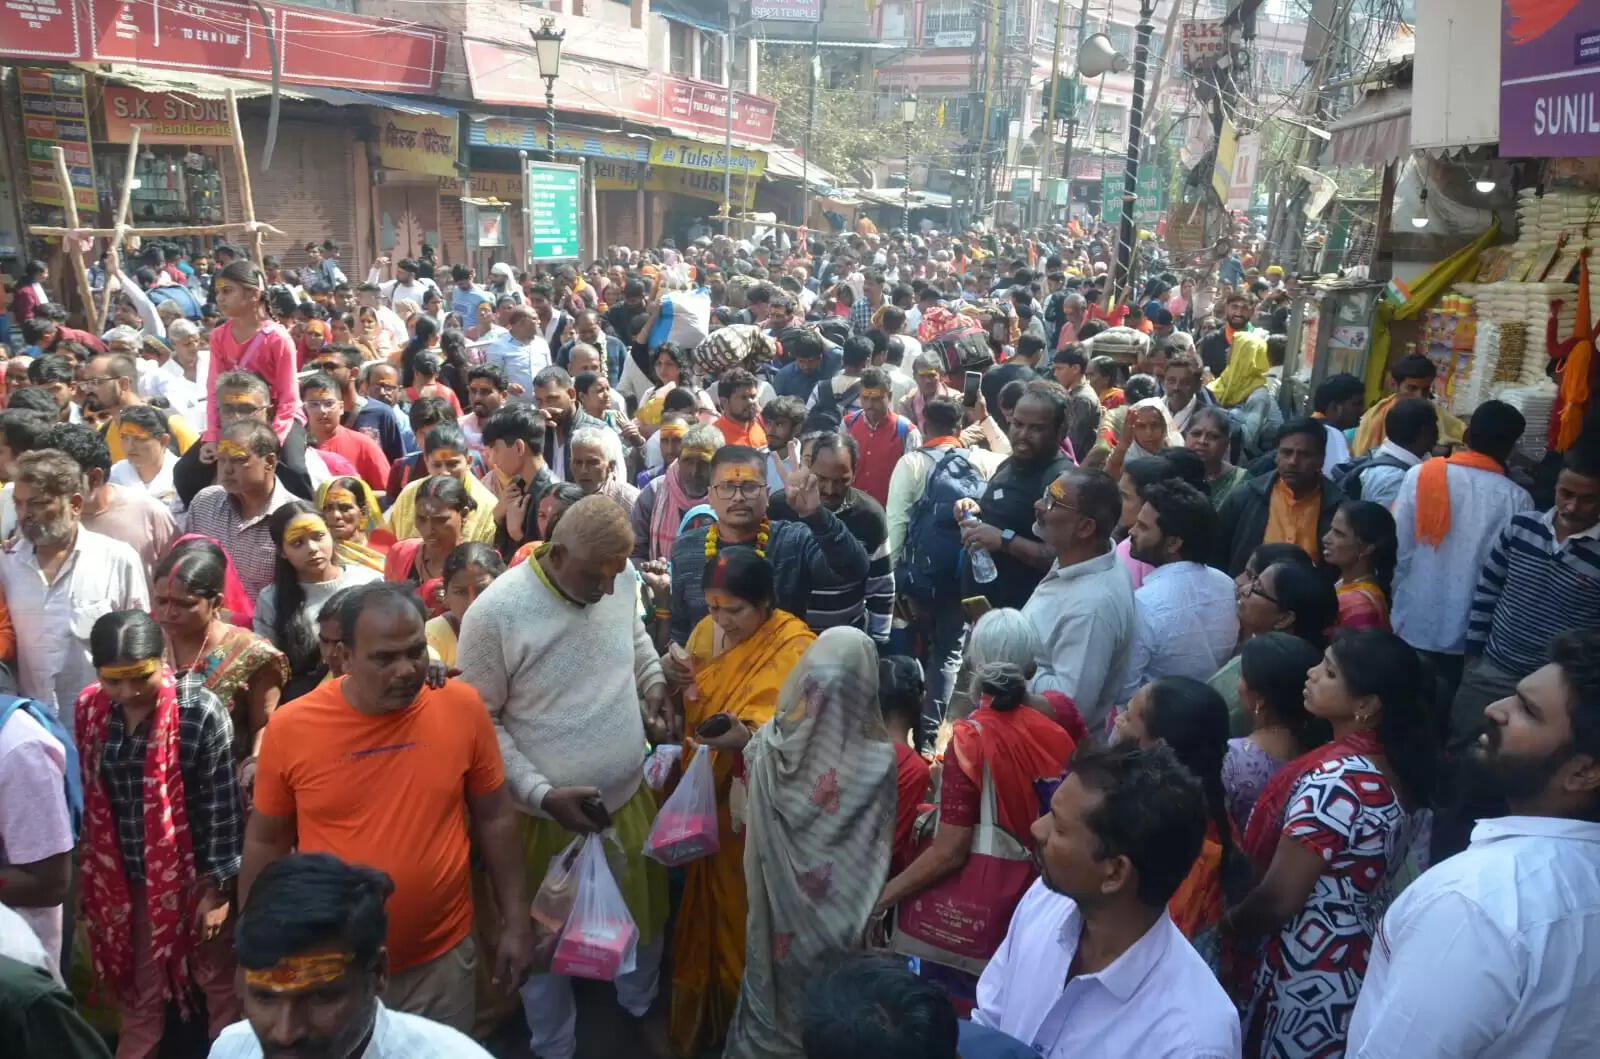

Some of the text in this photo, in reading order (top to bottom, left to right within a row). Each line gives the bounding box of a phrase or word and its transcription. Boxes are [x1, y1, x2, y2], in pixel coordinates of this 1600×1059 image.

[781, 8, 817, 17] TEMPLE
[164, 99, 230, 121] STONE
[1534, 92, 1600, 135] SUNIL
[680, 145, 713, 167] Tulsi
